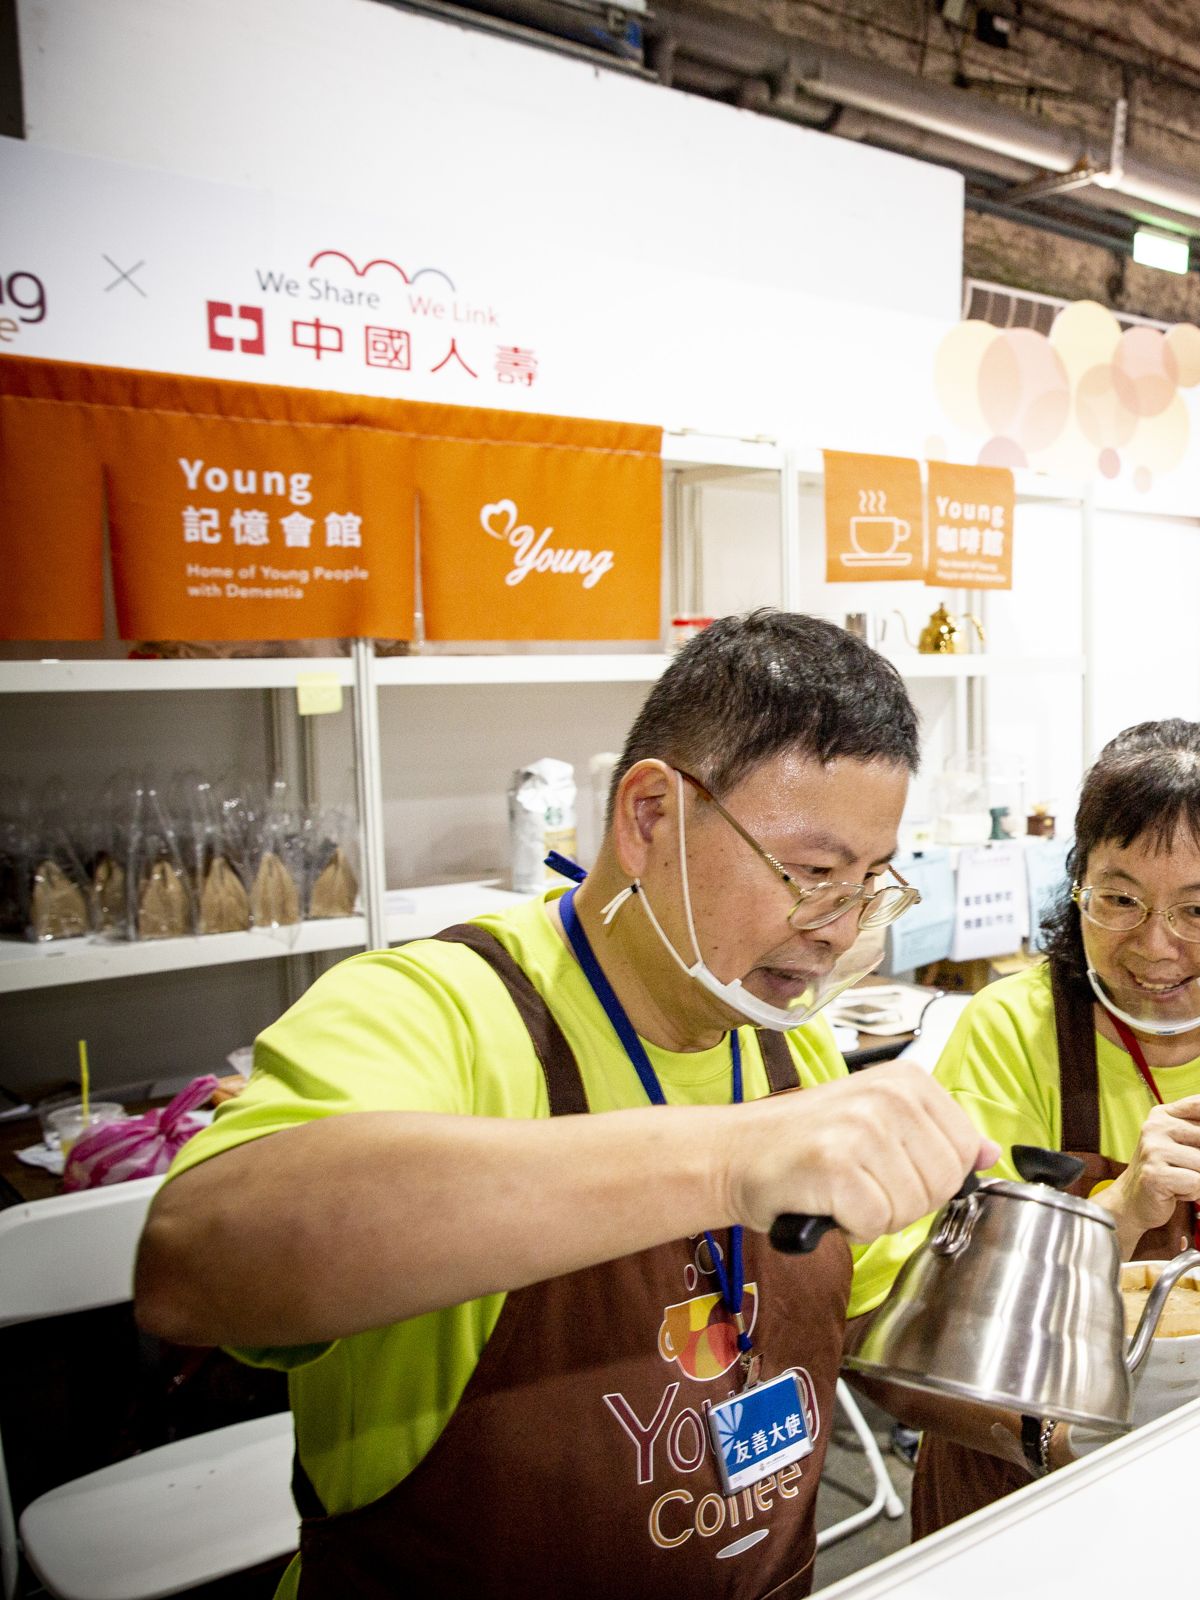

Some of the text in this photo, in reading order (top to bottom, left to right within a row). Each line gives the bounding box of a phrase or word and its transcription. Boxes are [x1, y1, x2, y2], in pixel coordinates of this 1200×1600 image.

[256, 269, 380, 309] We Share
[408, 294, 499, 327] We Link
[291, 317, 539, 387] 中國人壽
[179, 458, 313, 505] Young
[182, 506, 363, 549] 記憶會館
[936, 496, 1006, 529] Young
[187, 563, 370, 584] Home of Young People
[505, 523, 614, 589] Young
[187, 583, 304, 599] with Dementia
[733, 1413, 803, 1464] 友善大使
